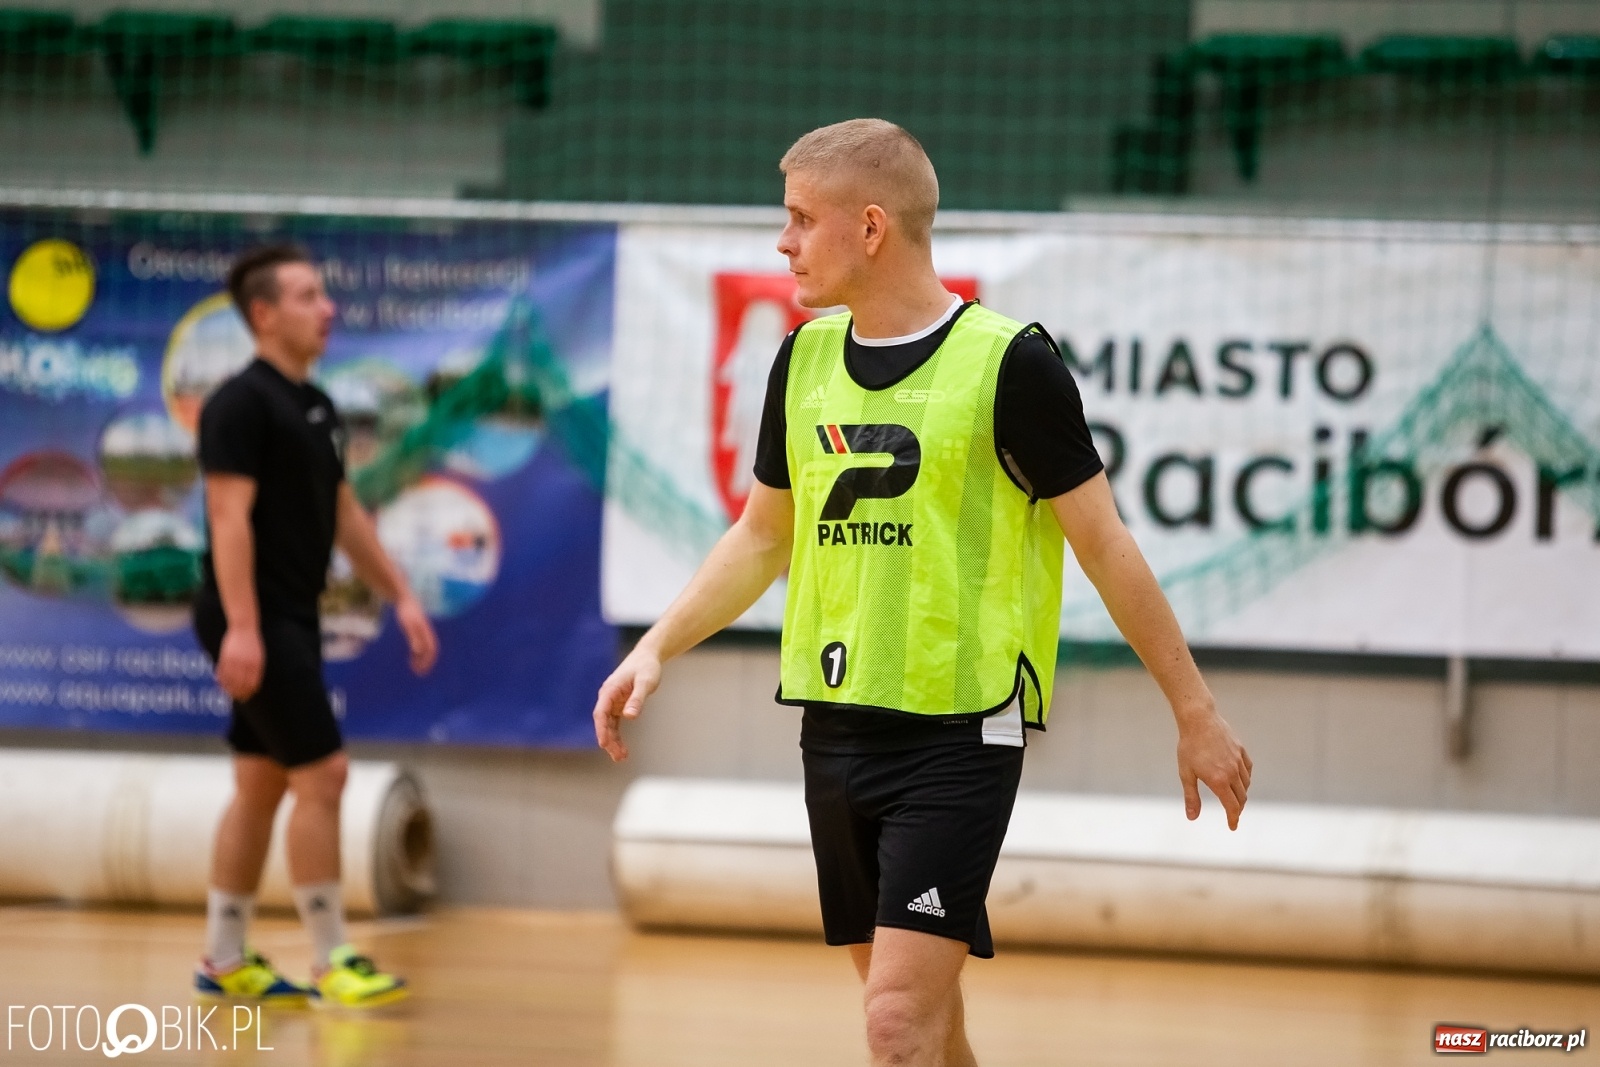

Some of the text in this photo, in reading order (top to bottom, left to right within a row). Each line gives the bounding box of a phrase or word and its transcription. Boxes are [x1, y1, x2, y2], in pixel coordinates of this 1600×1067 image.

[1058, 336, 1375, 401] MIASTO
[1086, 420, 1600, 546] acibór
[817, 522, 914, 547] PATRICK
[828, 646, 842, 685] 1
[907, 902, 946, 918] adidas
